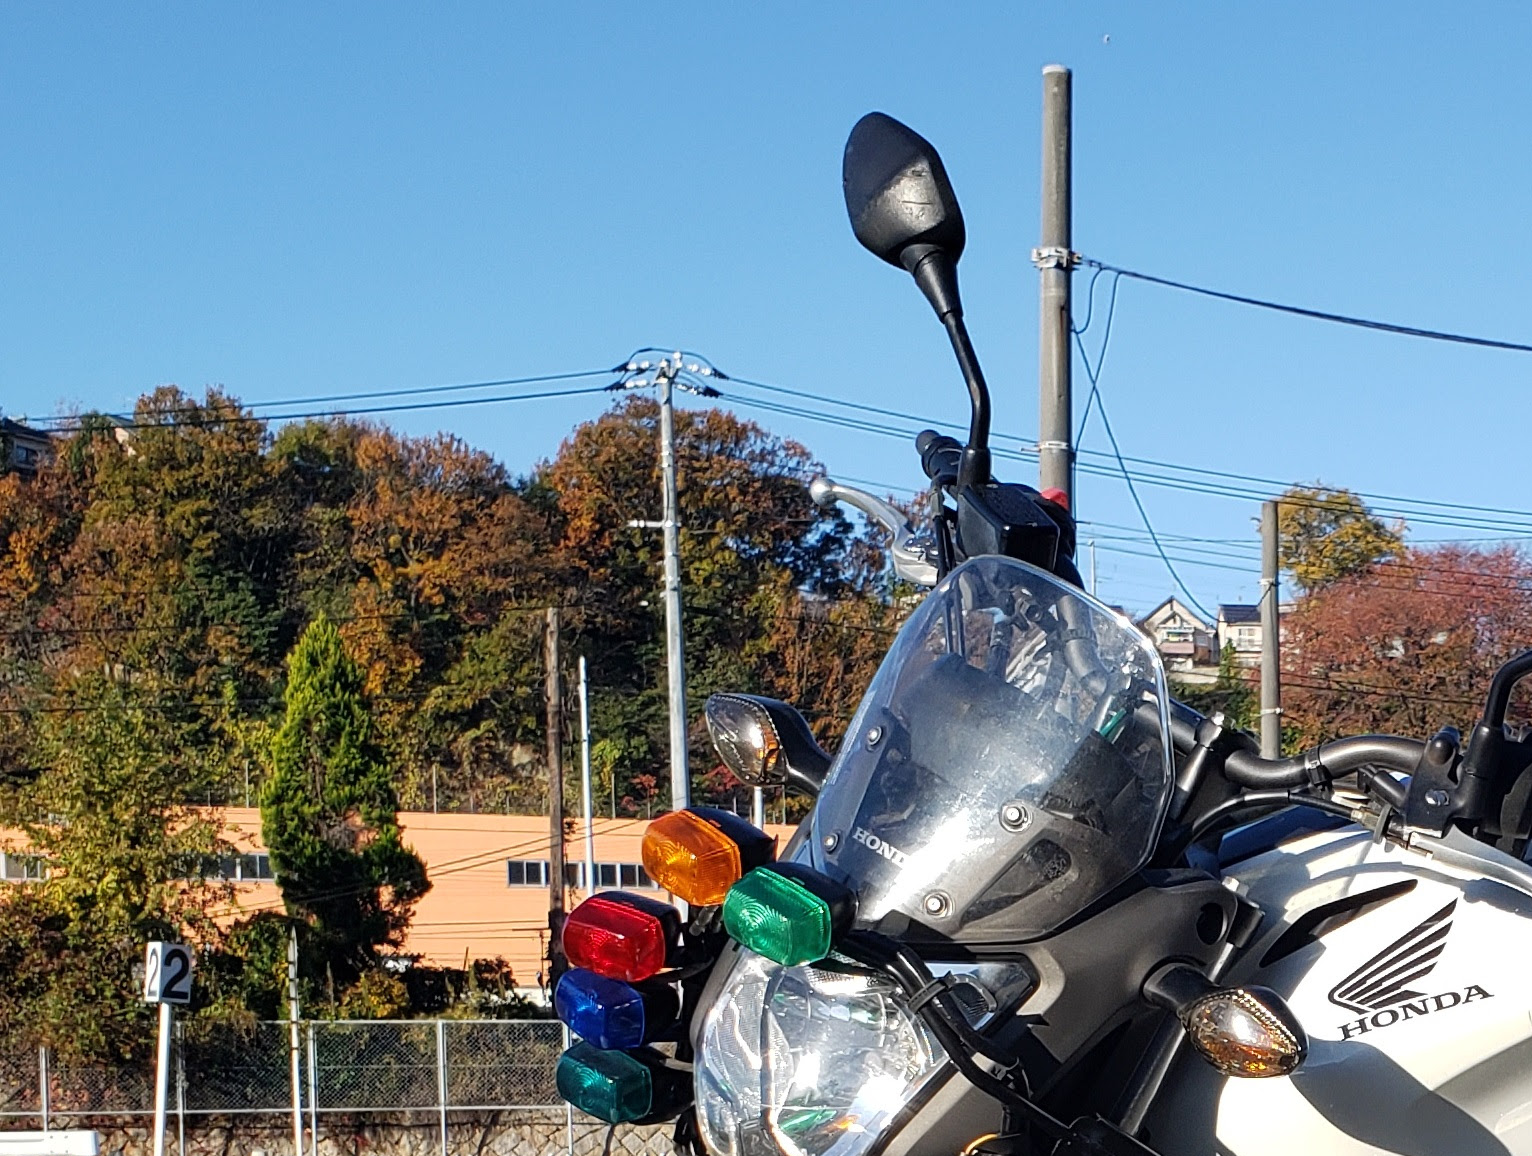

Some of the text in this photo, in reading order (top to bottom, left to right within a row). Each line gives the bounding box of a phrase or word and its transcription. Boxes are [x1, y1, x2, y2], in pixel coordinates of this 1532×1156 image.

[852, 826, 912, 871] HOND
[161, 948, 190, 1000] 2
[1337, 984, 1495, 1042] HONDA
